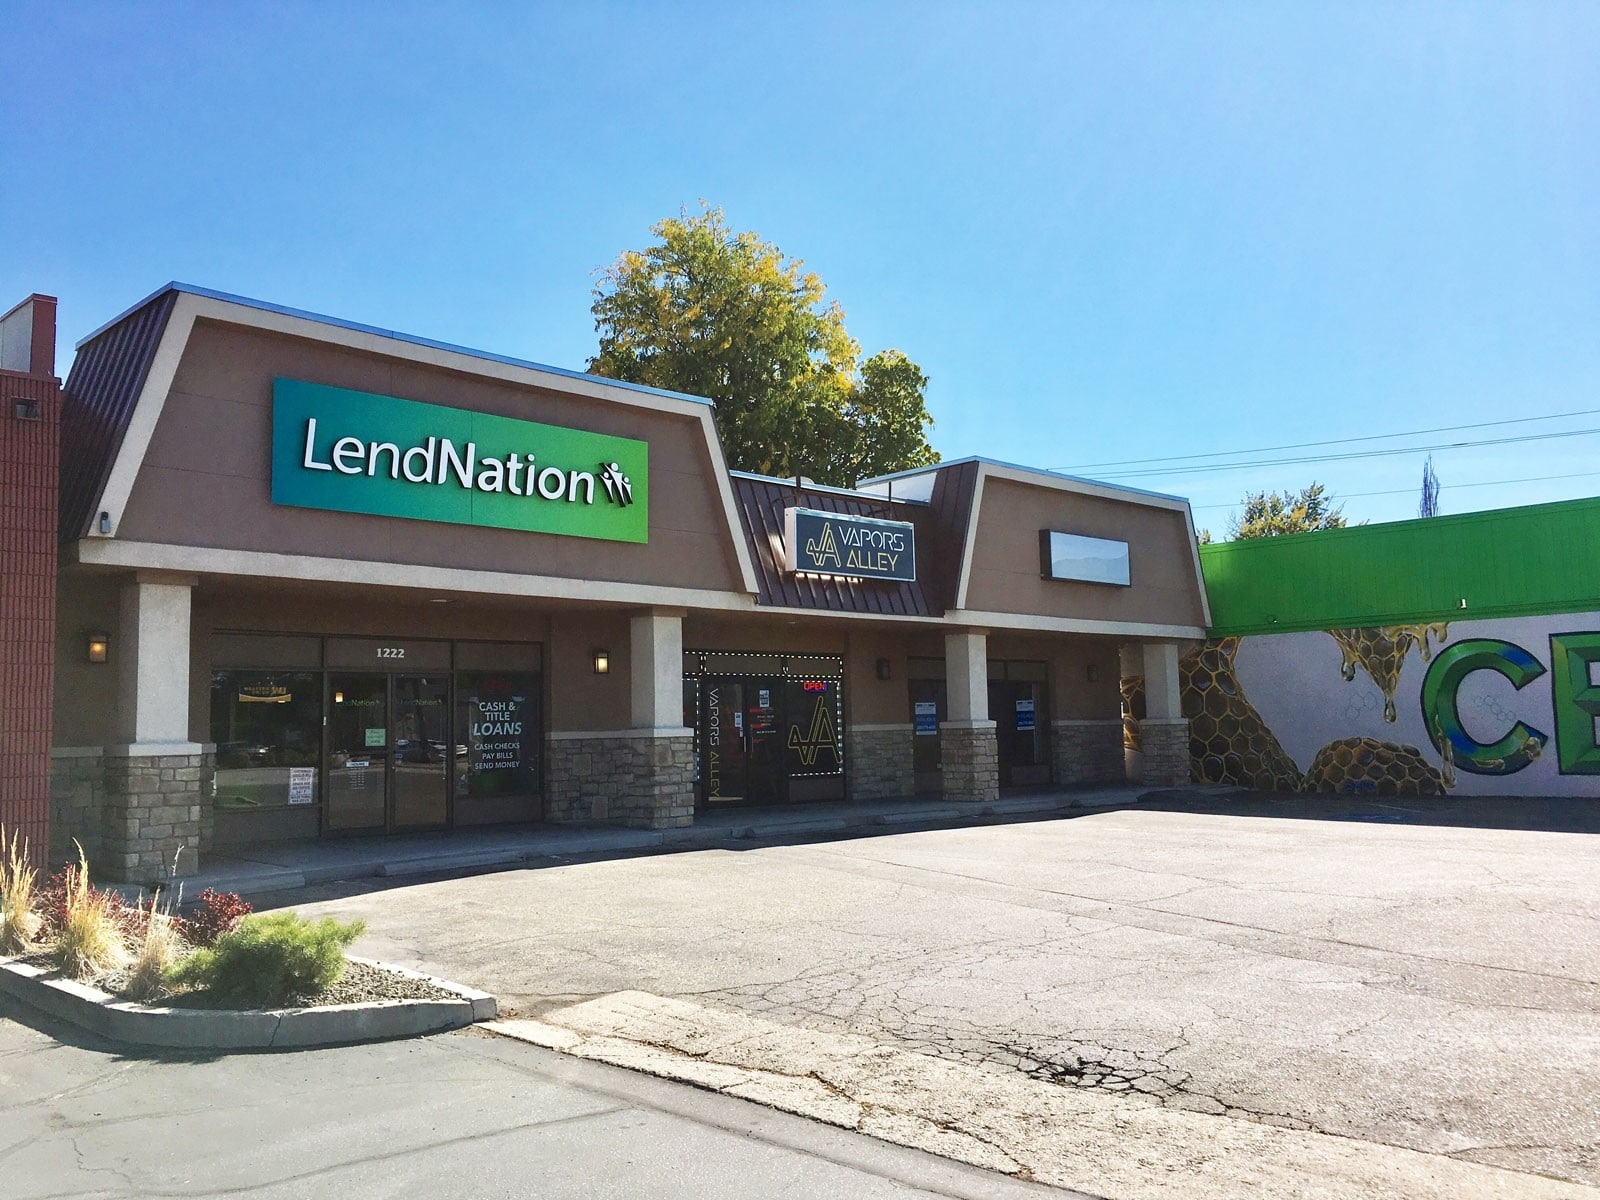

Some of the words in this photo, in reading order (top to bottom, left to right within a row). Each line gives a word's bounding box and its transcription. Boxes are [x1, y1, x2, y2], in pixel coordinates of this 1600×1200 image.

[303, 418, 595, 505] LendNation
[838, 525, 905, 552] VAPORS
[846, 548, 899, 572] ALLEY
[376, 648, 405, 658] 1222
[804, 682, 825, 691] OPEN
[479, 702, 506, 711] CASH
[508, 702, 517, 711] &
[485, 712, 510, 721] TITLE
[709, 688, 720, 746] VAPORS
[473, 722, 522, 736] LOANS
[474, 743, 493, 751] CASH
[494, 742, 520, 750] CHECKS
[482, 752, 495, 760] PAY
[496, 751, 513, 759] BILLS
[475, 762, 494, 770] SEND
[495, 760, 520, 769] MONEY
[709, 751, 720, 797] ALLEY
